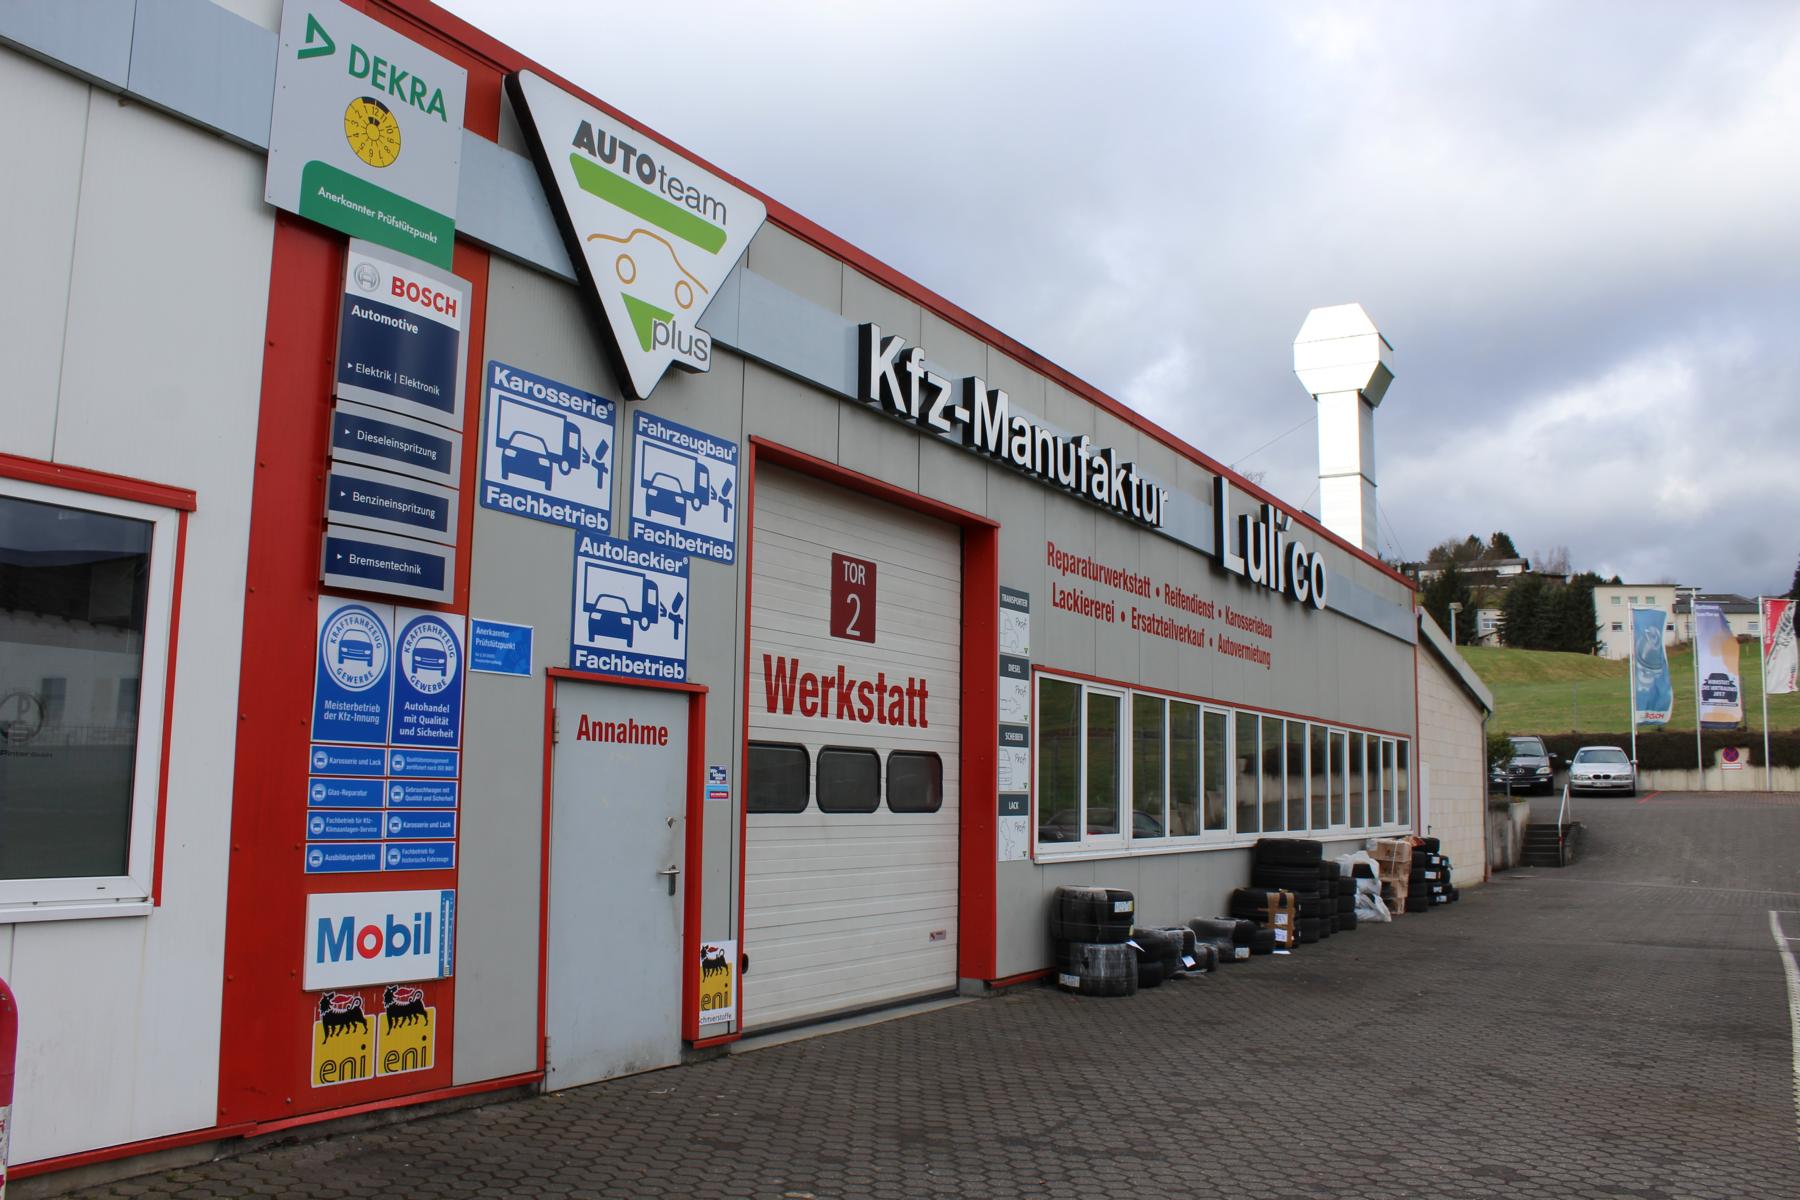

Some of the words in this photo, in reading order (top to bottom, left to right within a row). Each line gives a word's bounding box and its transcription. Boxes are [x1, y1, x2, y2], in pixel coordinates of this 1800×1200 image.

[348, 44, 448, 122] DEKRA
[385, 125, 393, 134] 10
[384, 145, 390, 153] 8
[571, 120, 728, 226] AUTOteam
[318, 186, 375, 217] Anerkannter
[377, 211, 438, 244] Prüfstützpunkt
[391, 275, 457, 318] BOSCH
[351, 304, 419, 334] Automotive
[651, 318, 708, 362] plus
[355, 362, 392, 381] Elektrik
[399, 374, 440, 396] Elektronik
[858, 322, 1168, 528] Kfz-Manufaktur
[357, 430, 437, 460] Dieseleinspritzung
[353, 491, 435, 519] Benzineinspritzung
[486, 486, 609, 531] Fachbetrieb
[633, 522, 732, 561] Fachbetrieb
[349, 554, 422, 575] Bremsentechnik
[842, 560, 866, 585] TOR
[1047, 541, 1151, 599] Reparaturwerkstatt
[1164, 583, 1215, 620] Reifendienst
[1225, 605, 1273, 639] Karosseriebau
[845, 593, 861, 636] 2
[1052, 582, 1114, 623] Lackiererei
[1131, 607, 1205, 648] Ersatzteilverkauf
[1218, 633, 1271, 670] Autovermietung
[331, 616, 383, 649] KRAFTFAHRZEUG
[404, 625, 455, 659] KRAFTFAHRZEUG
[336, 667, 374, 684] GEWERBE
[575, 650, 684, 680] Fachbetrieb
[410, 675, 447, 693] GEWERBE
[763, 653, 928, 728] Werkstatt
[324, 700, 381, 713] Meisterbetrieb
[324, 711, 337, 720] der
[338, 712, 380, 725] Kfz-Innung
[404, 702, 450, 713] Autohandel
[404, 715, 417, 724] mit
[418, 715, 449, 726] Qualität
[400, 727, 415, 736] und
[416, 728, 454, 738] Sicherheit
[576, 714, 668, 747] Annahme
[1008, 801, 1019, 810] LACK
[316, 912, 432, 964] Mobil
[701, 983, 728, 1011] eni
[319, 1044, 366, 1084] eni
[383, 1035, 427, 1073] eni
